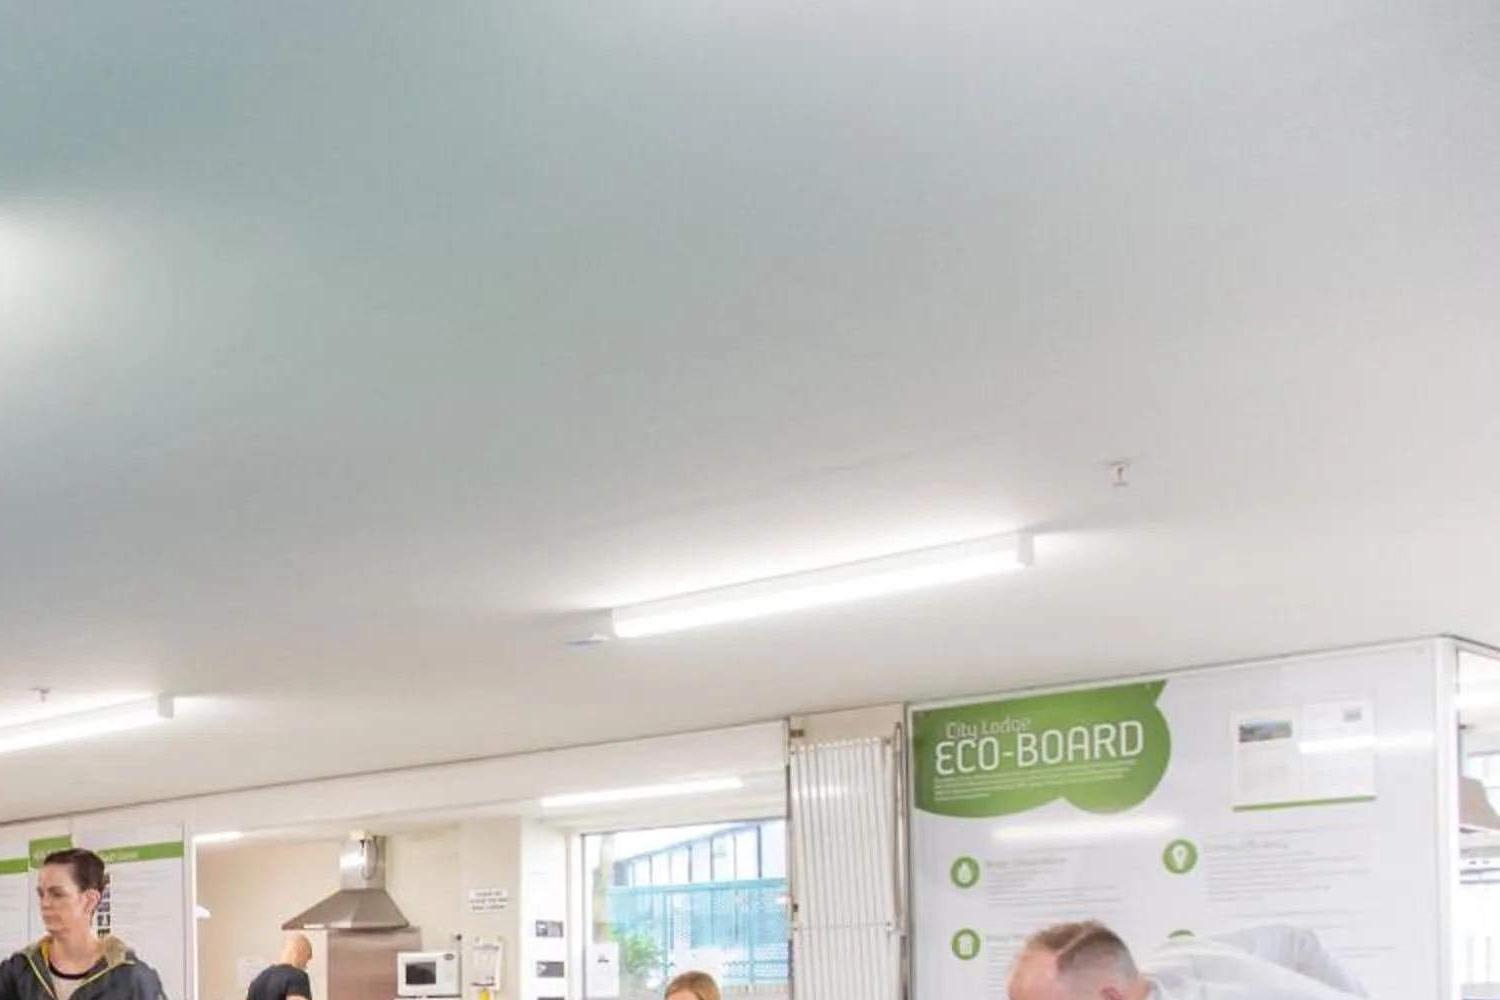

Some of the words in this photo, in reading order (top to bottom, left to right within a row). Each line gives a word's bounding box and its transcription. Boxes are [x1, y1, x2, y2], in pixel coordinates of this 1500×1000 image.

[935, 720, 1144, 775] ECO-BOARD
[945, 721, 978, 741] City
[982, 716, 1032, 736] Lodge
